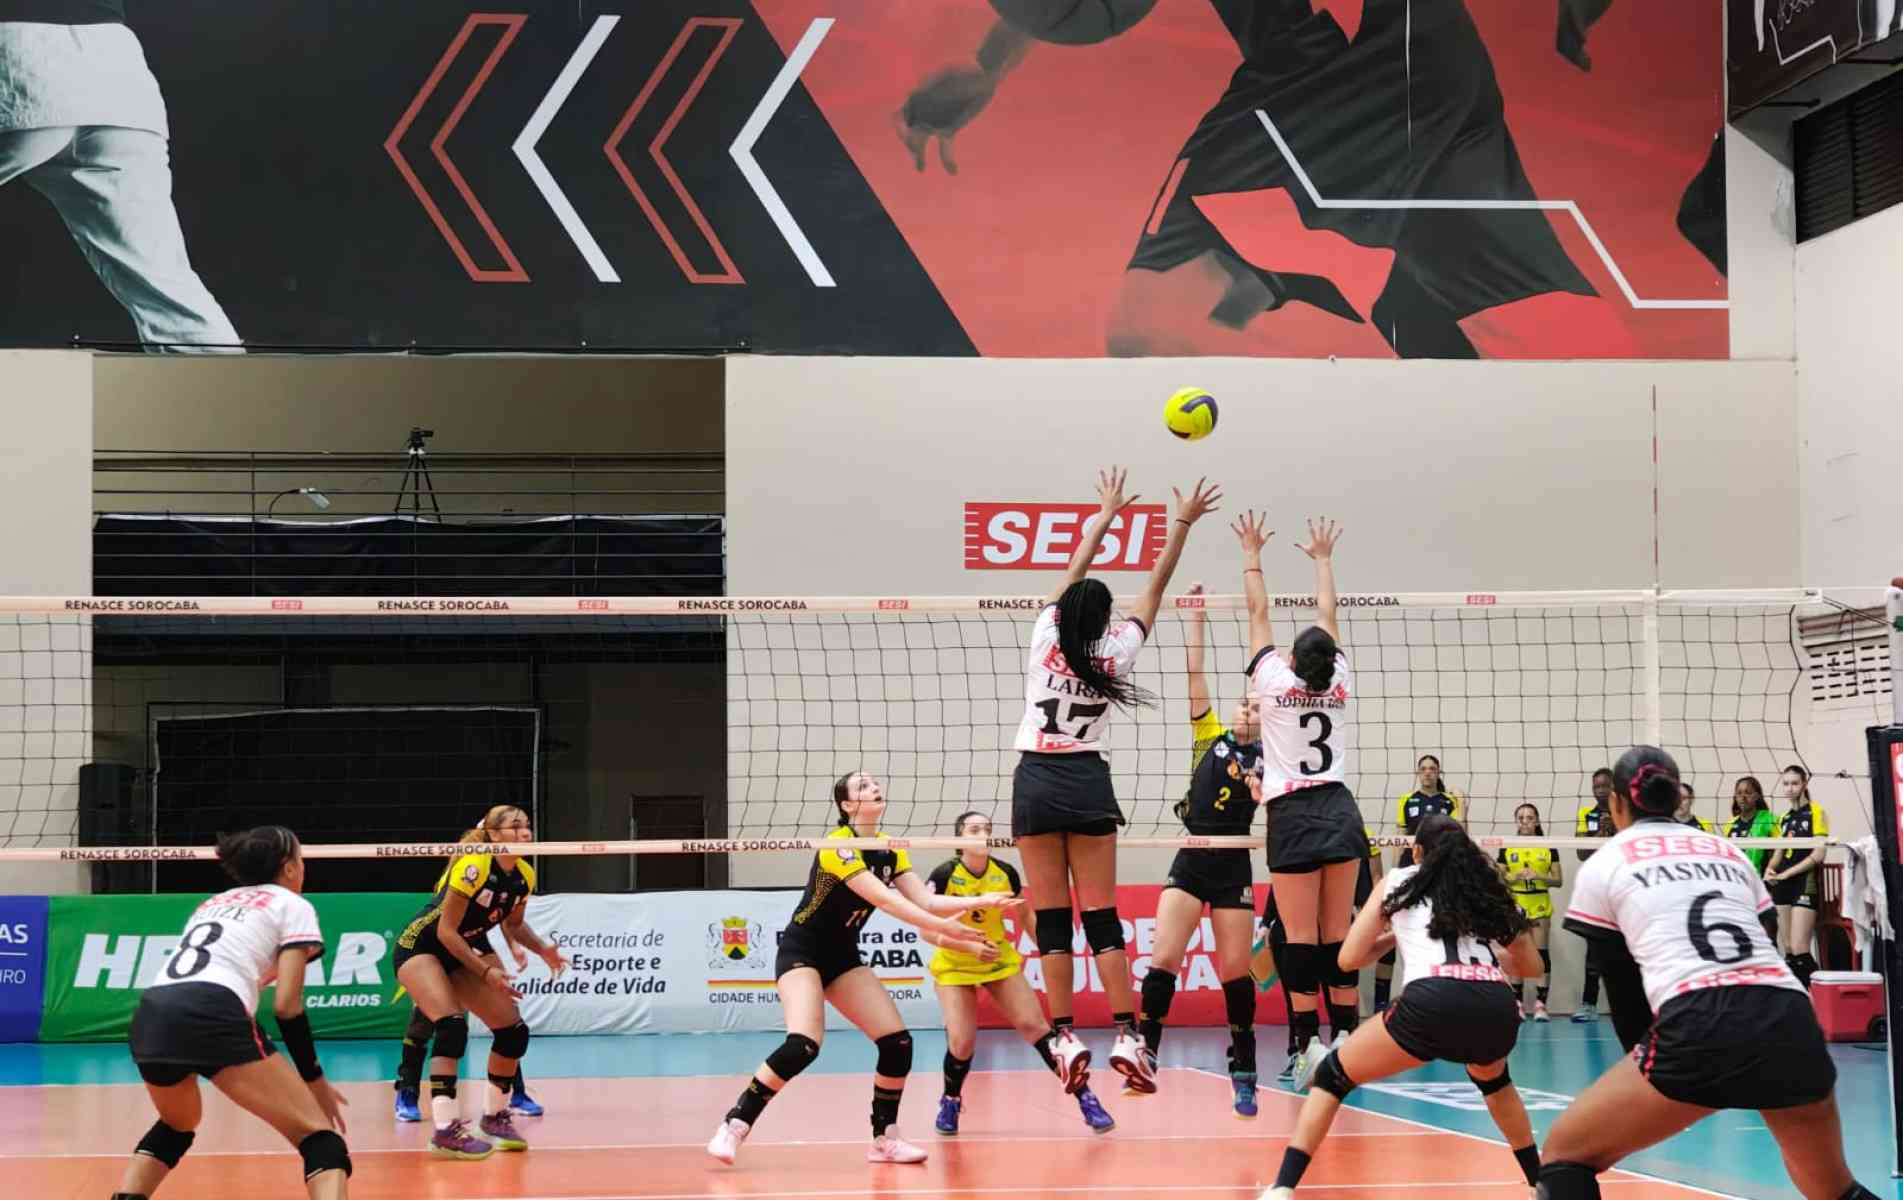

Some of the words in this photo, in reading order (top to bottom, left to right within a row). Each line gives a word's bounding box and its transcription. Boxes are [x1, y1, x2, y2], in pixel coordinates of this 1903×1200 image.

[982, 510, 1149, 565] SESI
[65, 600, 124, 610] RENASCE
[128, 600, 200, 610] SOROCABA
[378, 600, 435, 610] RENASCE
[439, 600, 510, 610] SOROCABA
[678, 600, 735, 610] RENASCE
[738, 600, 808, 610] SOROCABA
[979, 599, 1031, 609] RENASCE
[1274, 597, 1318, 608] RENAS
[1035, 698, 1108, 740] 17
[1299, 711, 1333, 776] 3
[1213, 786, 1232, 811] 2
[376, 846, 434, 857] RENASCE
[438, 844, 510, 855] SOROCABA
[682, 841, 739, 852] RENASCE
[742, 839, 812, 850] SOROCABA
[60, 849, 119, 860] RENASCE
[124, 848, 196, 860] SOROCABA
[1633, 862, 1750, 888] YASMIN
[1687, 889, 1753, 964] 6
[550, 930, 638, 949] Secretaria
[643, 927, 665, 947] de
[891, 928, 918, 944] de
[166, 922, 224, 979] 8
[571, 954, 646, 975] Esporte
[650, 956, 662, 970] e
[511, 977, 590, 995] alidade
[594, 977, 618, 995] de
[623, 975, 667, 994] Vida
[306, 994, 381, 1008] CLARIOS
[709, 992, 755, 1004] CIDADE
